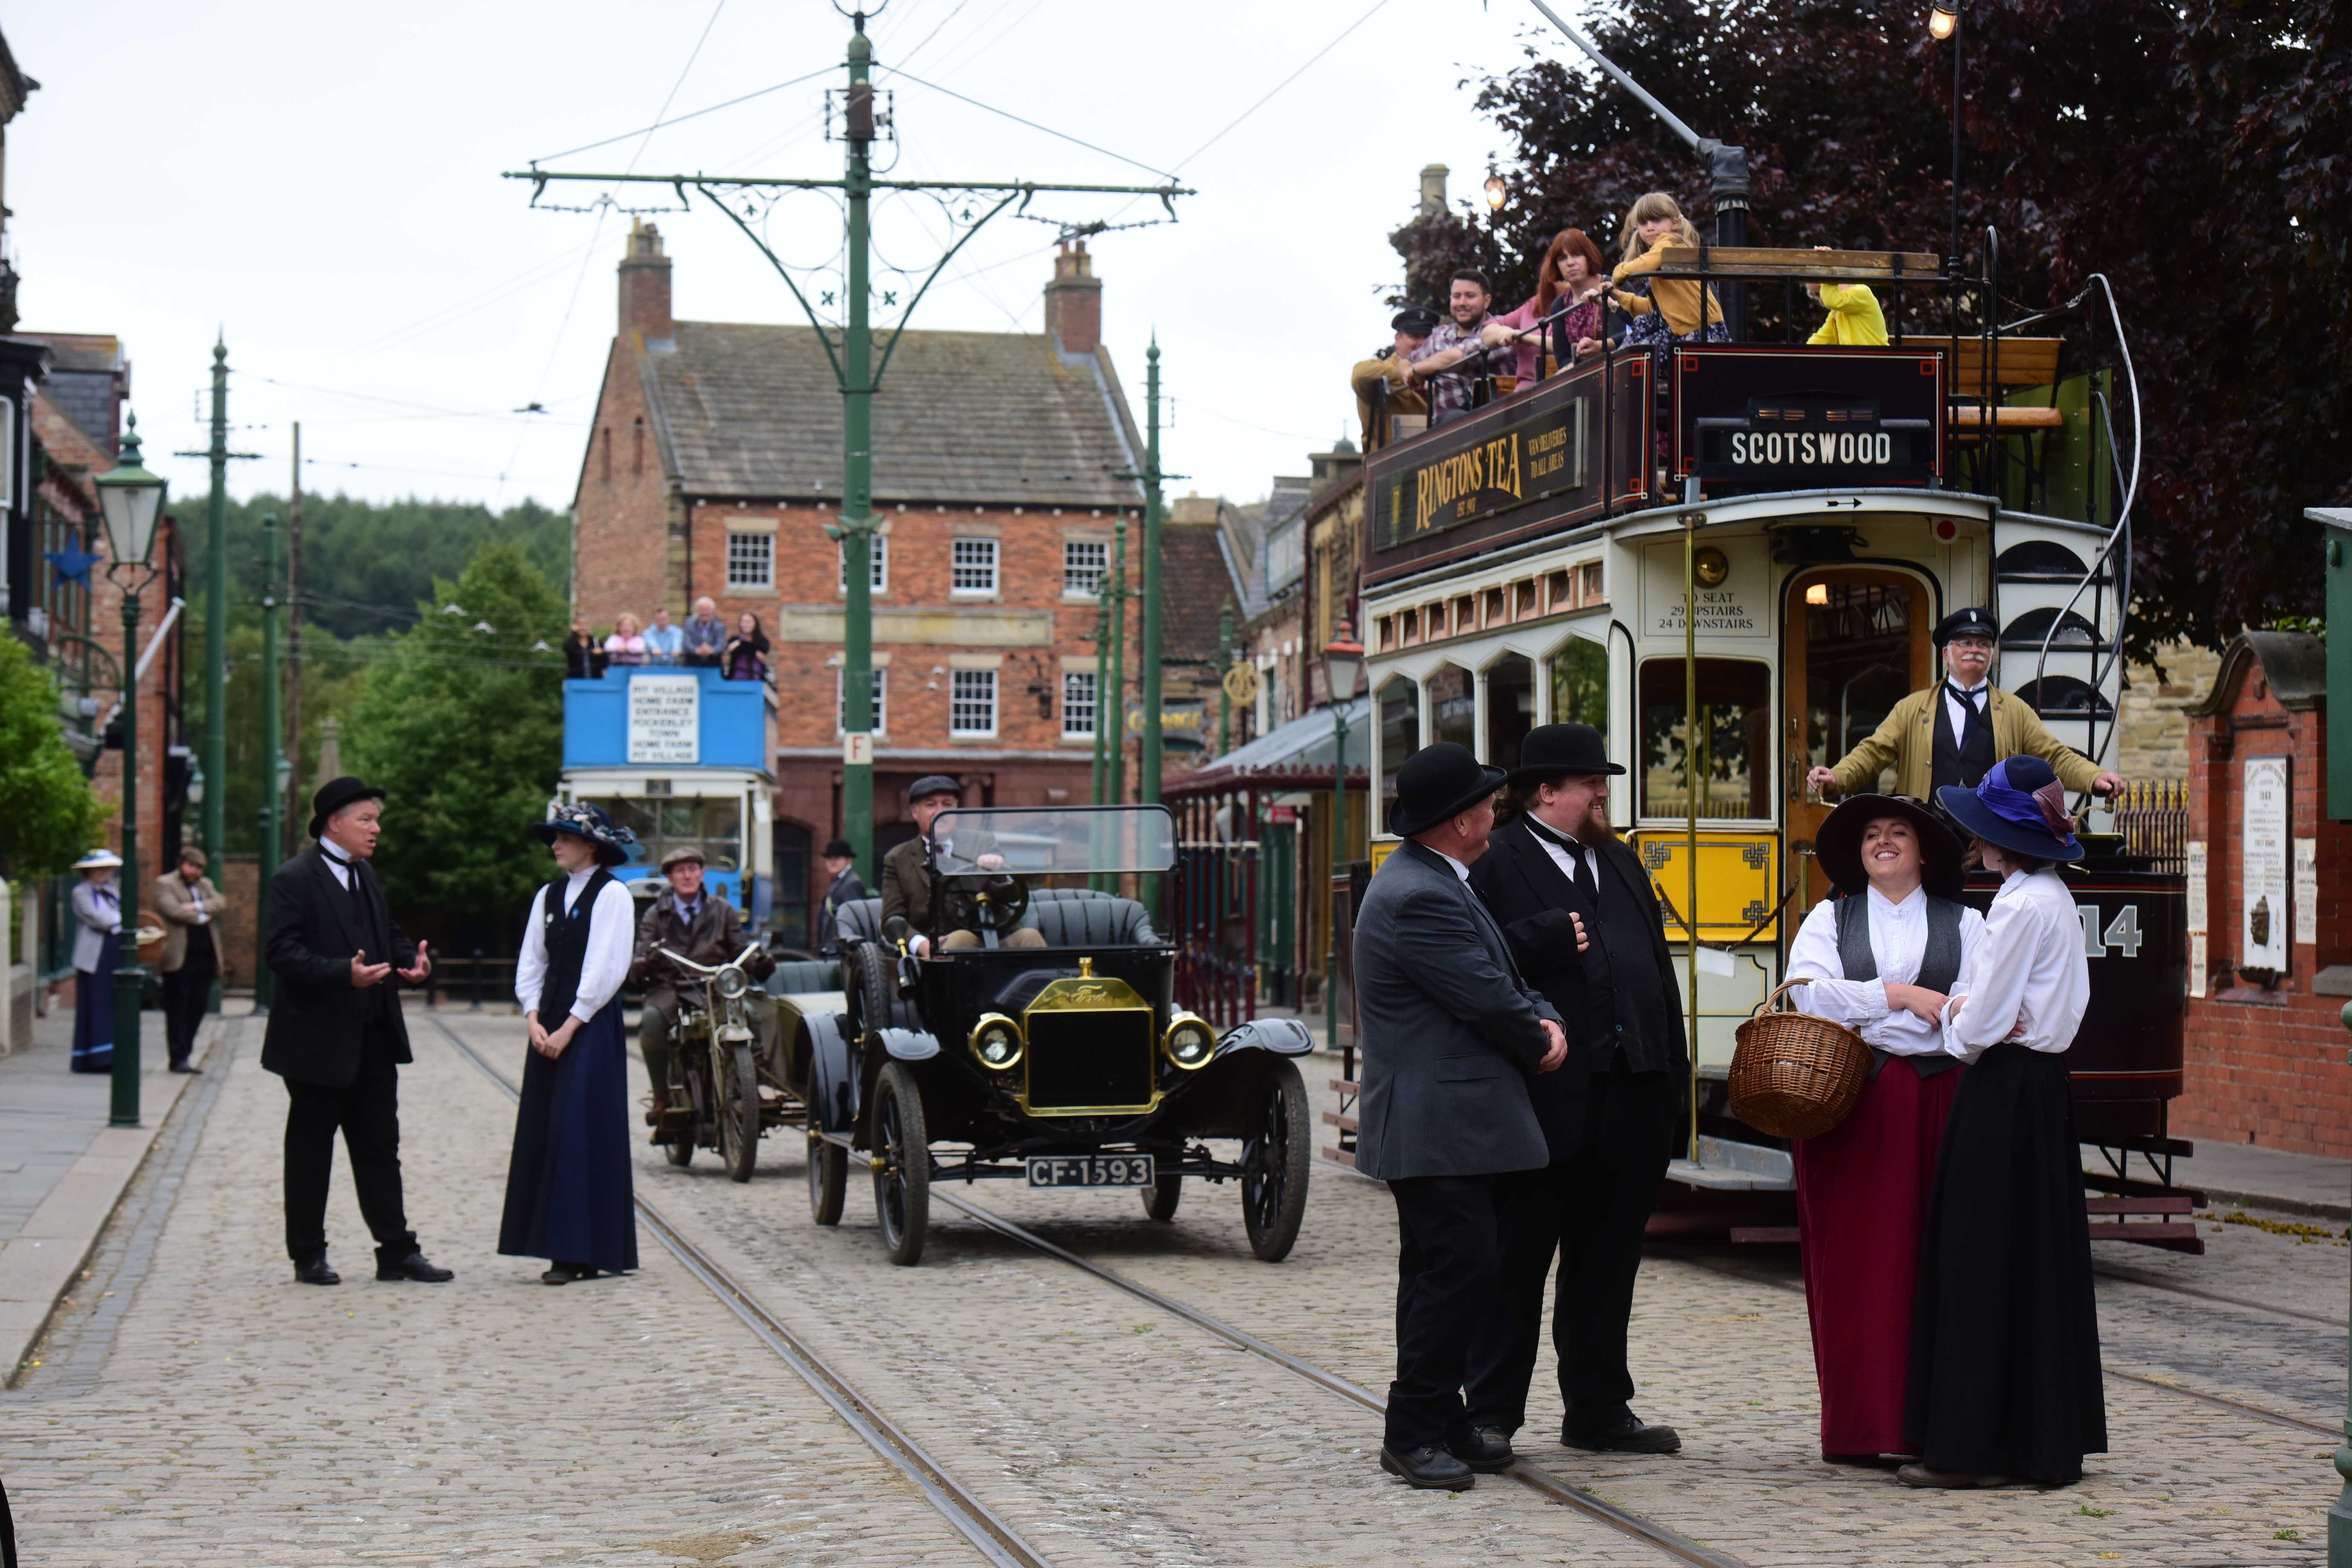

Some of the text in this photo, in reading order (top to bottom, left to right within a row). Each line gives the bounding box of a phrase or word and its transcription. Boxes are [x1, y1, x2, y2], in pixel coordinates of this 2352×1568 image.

[1528, 426, 1567, 456] VAN DELIVERIES
[1732, 432, 1890, 464] SCOTSWOOD
[1531, 450, 1564, 478] TO ALL AREAS
[1416, 433, 1522, 532] RINGTONS TEA
[1703, 592, 1735, 603] SEAT
[1671, 605, 1685, 616] 29
[1659, 619, 1753, 629] 24 DWNSTAIRS
[636, 707, 689, 715] ENTRANCE
[649, 729, 680, 737] TOWN
[853, 736, 864, 758] F
[1071, 985, 1107, 1003] Ford
